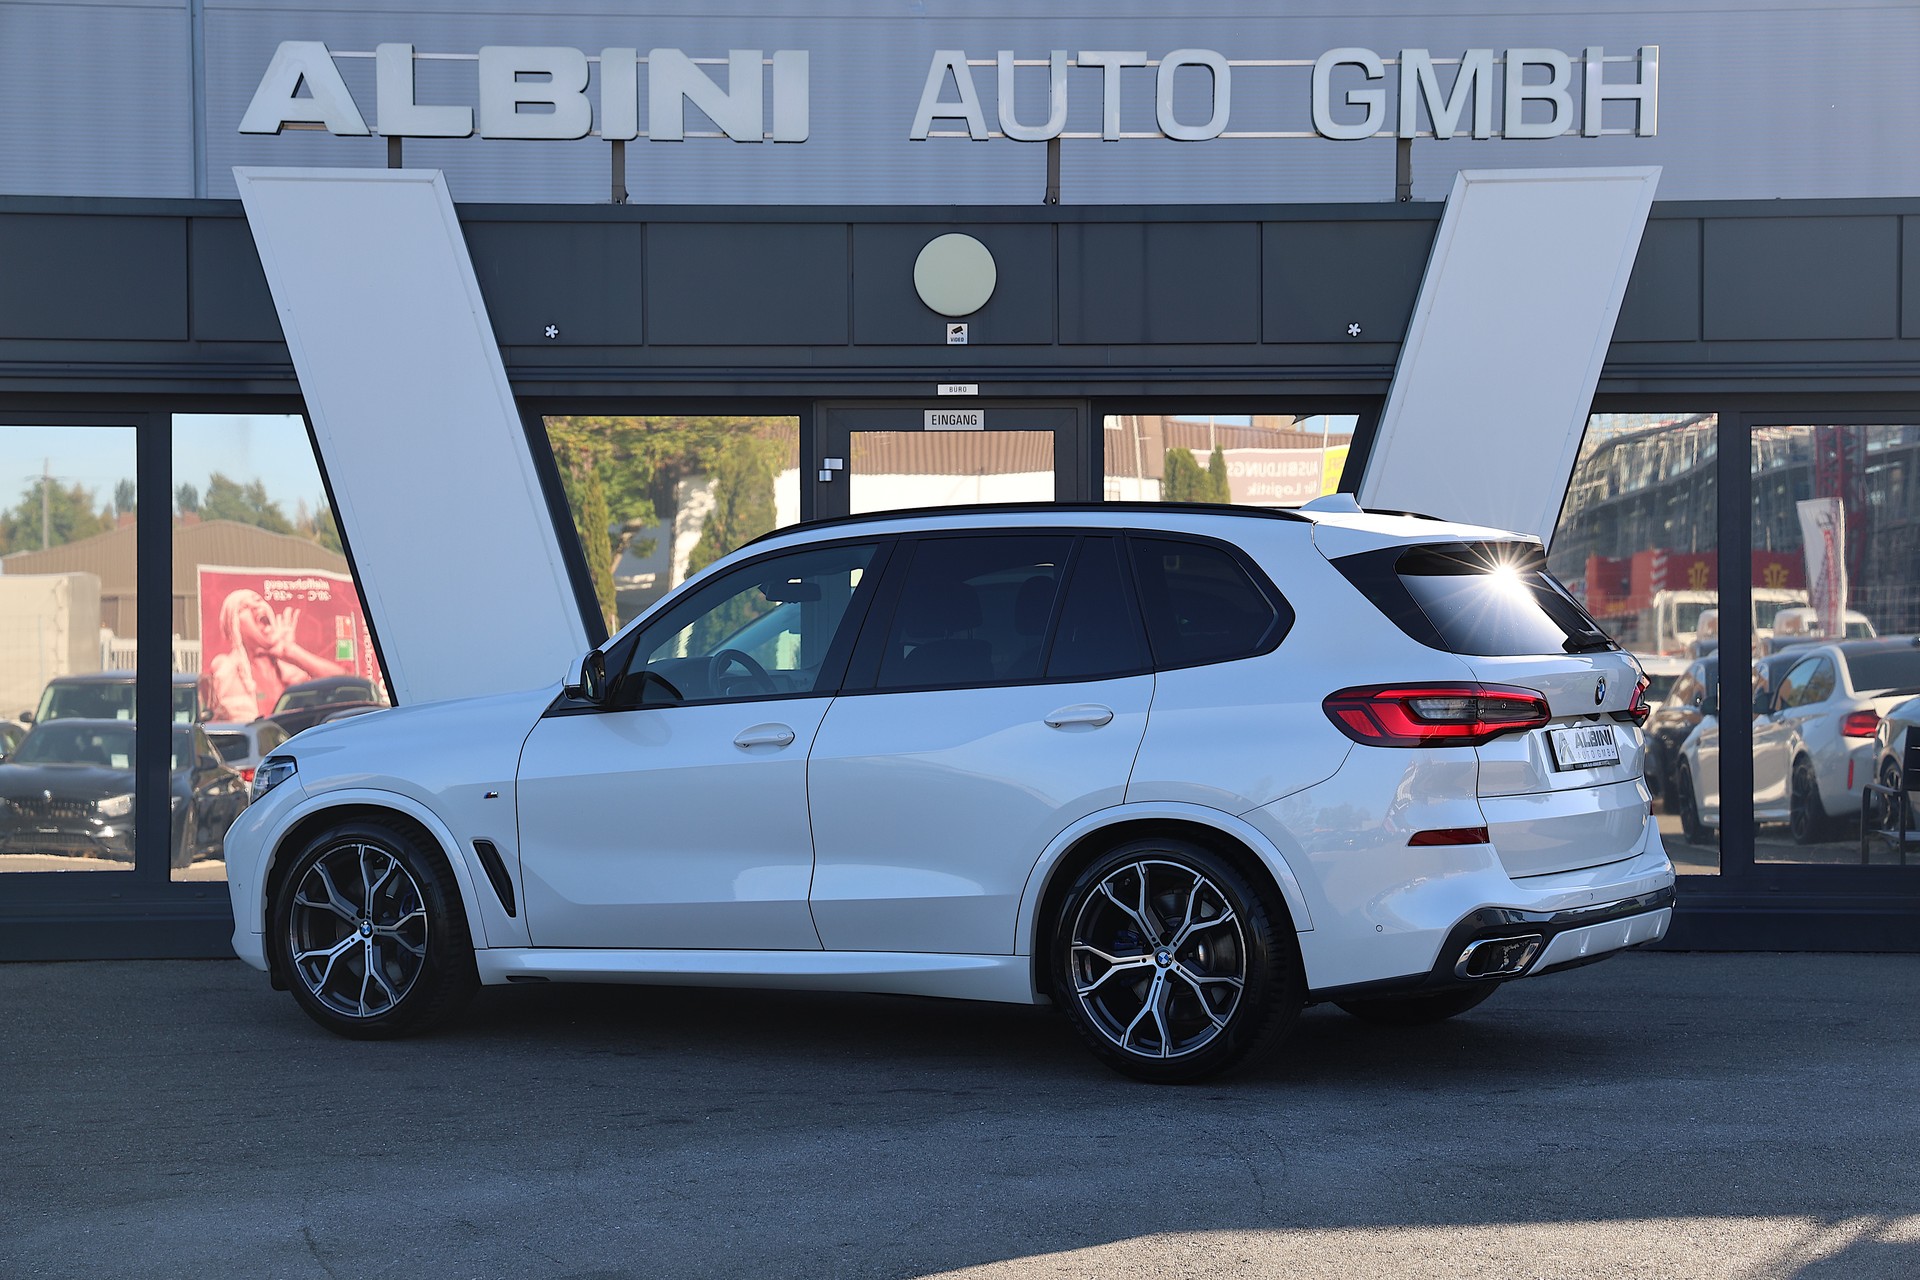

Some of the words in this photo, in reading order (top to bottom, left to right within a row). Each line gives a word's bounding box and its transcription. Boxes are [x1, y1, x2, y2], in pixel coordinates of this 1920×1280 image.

[238, 41, 809, 143] ALBINI
[910, 48, 1231, 142] AUTO
[1311, 45, 1659, 140] GMBH
[931, 414, 977, 426] EINGANG
[1575, 729, 1613, 748] ALBINI
